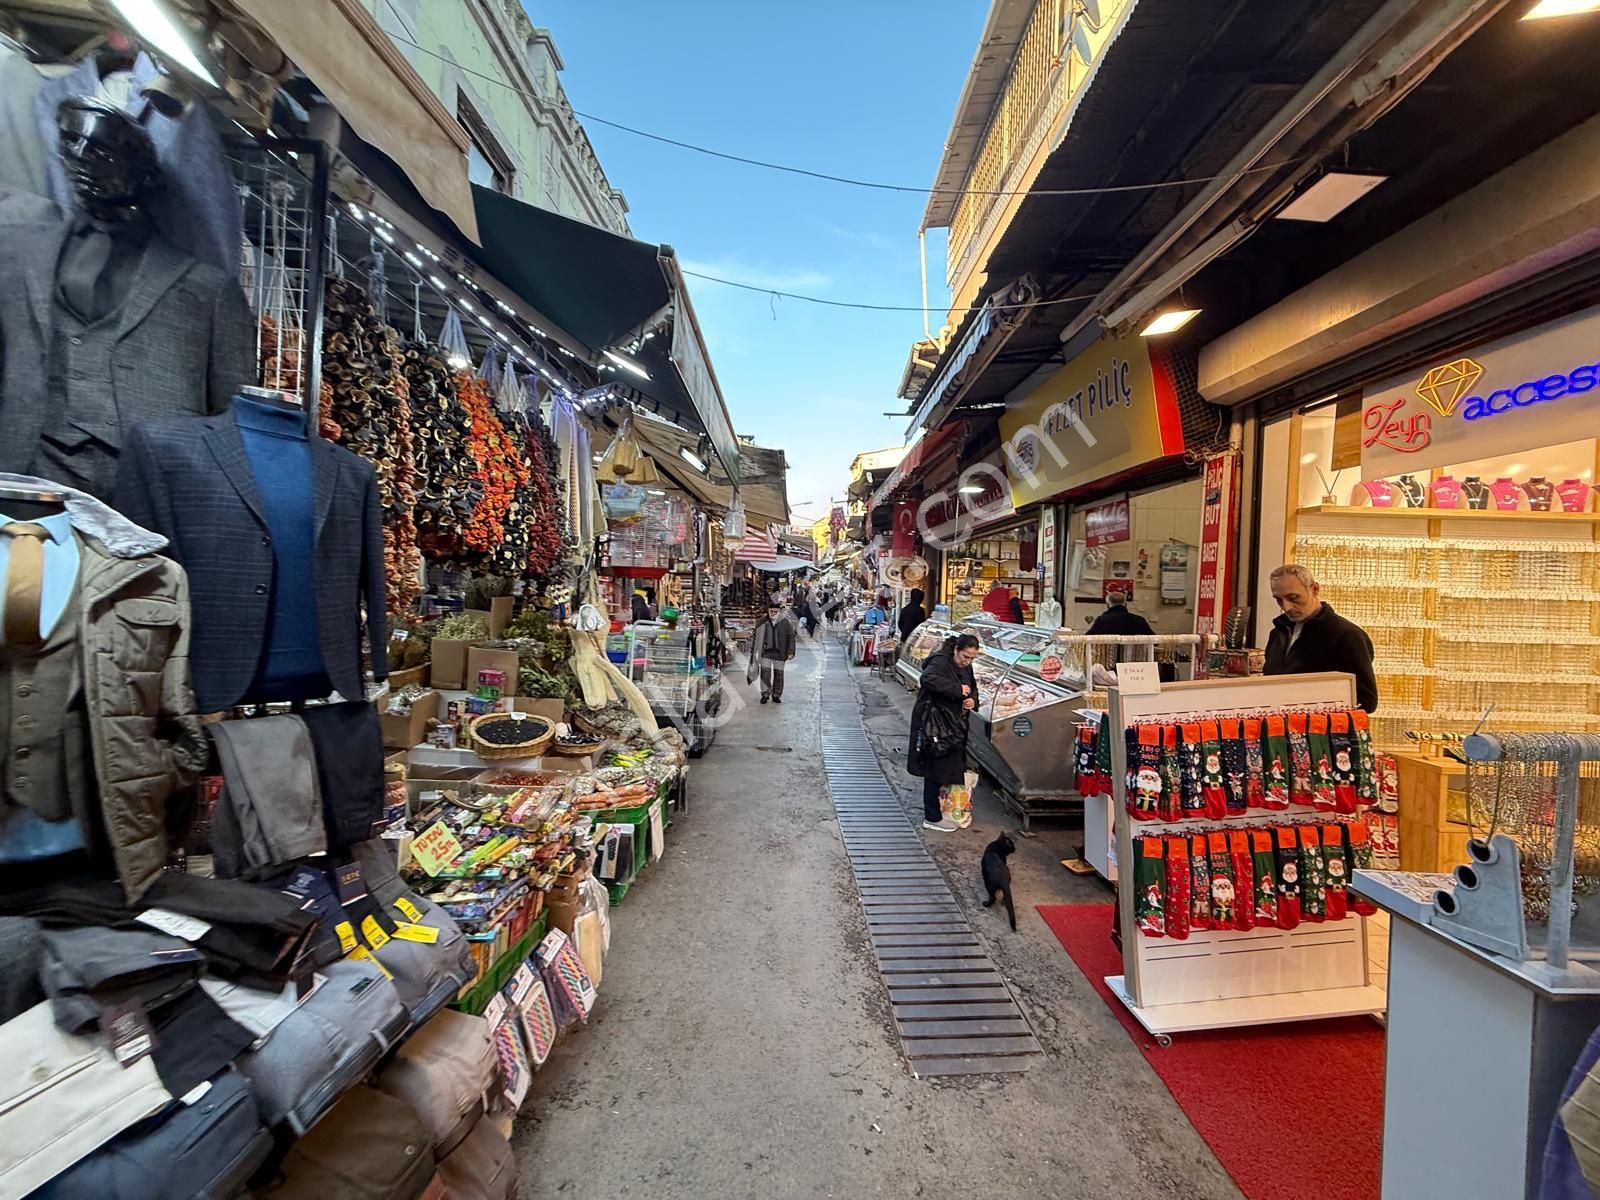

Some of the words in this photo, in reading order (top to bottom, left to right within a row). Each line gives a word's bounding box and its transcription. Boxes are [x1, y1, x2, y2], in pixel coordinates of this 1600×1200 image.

[1086, 357, 1133, 417] PİLİÇ
[1363, 397, 1432, 452] Zeyn
[1204, 503, 1221, 525] BUT
